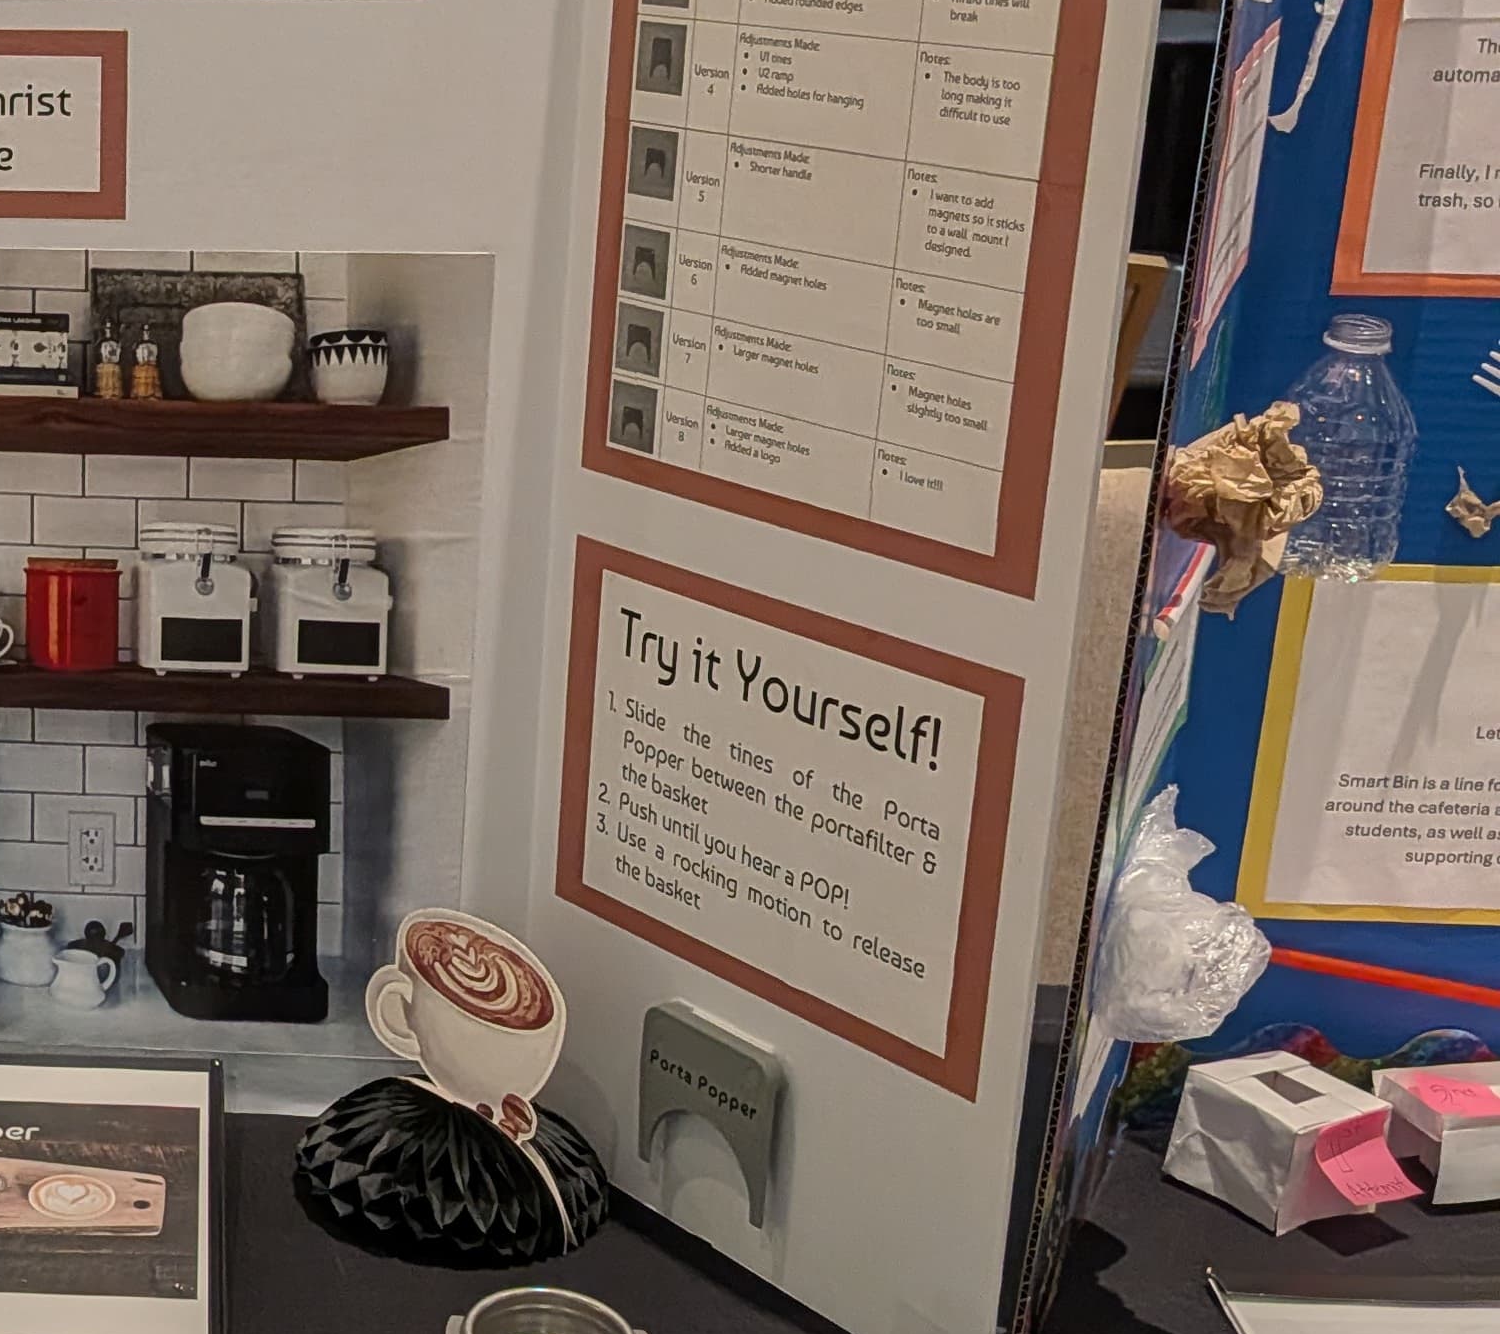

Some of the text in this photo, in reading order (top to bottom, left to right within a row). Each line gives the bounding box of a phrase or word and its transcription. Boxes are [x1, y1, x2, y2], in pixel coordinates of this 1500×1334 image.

[1419, 163, 1480, 183] Finally,
[1418, 193, 1493, 209] trash, so
[620, 606, 942, 772] Try it Yourself!
[608, 690, 940, 842] 1. Slide the tines of the Porta
[621, 762, 709, 816] the basket
[1338, 774, 1484, 792] Smart Bin is a line
[623, 729, 938, 875] Popper between the portafilter &
[1325, 800, 1491, 816] around the cafeteria
[1345, 824, 1483, 840] students, as well
[1405, 850, 1493, 867] supporting
[649, 1048, 757, 1121] Porta Popper
